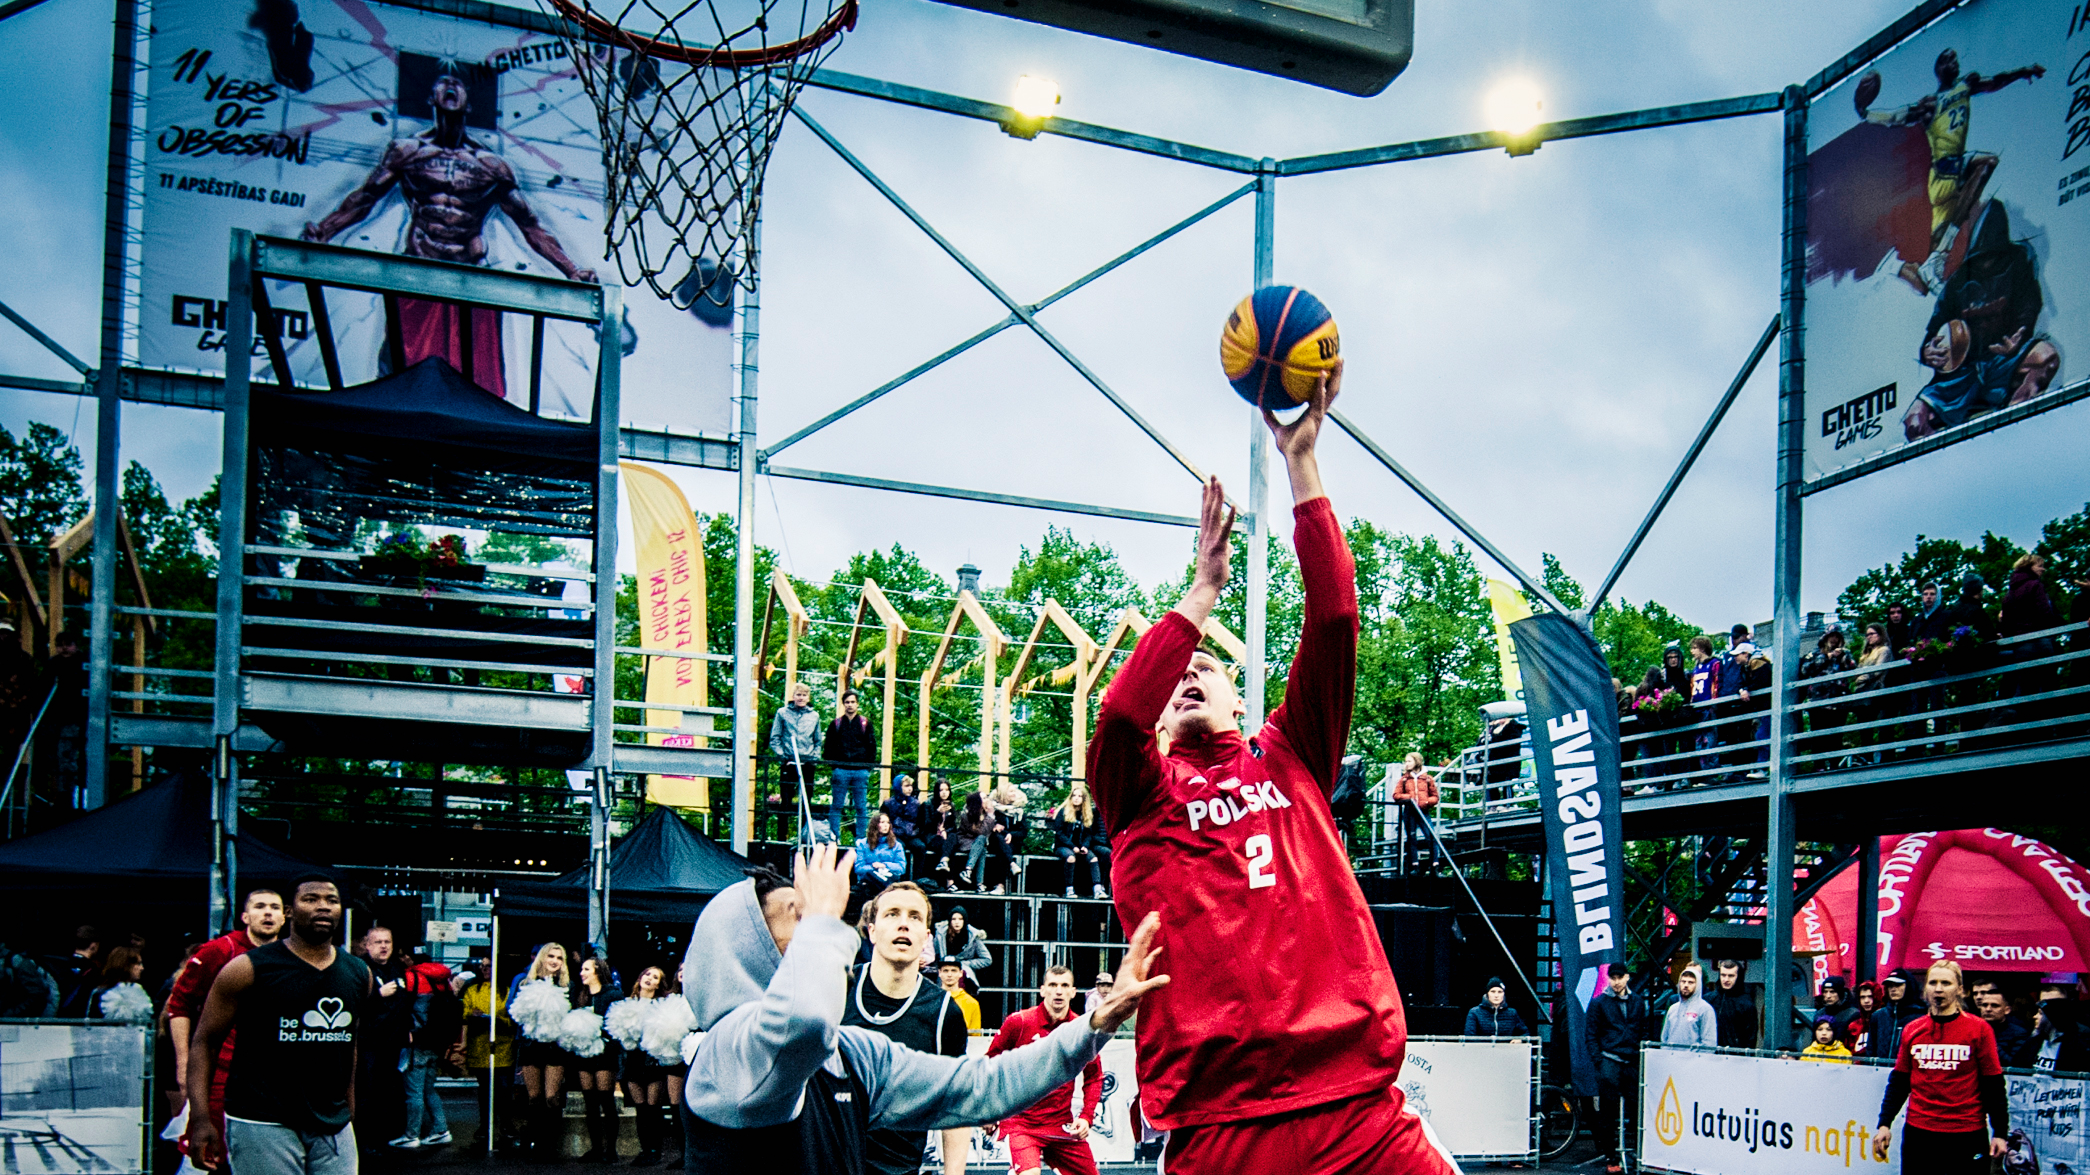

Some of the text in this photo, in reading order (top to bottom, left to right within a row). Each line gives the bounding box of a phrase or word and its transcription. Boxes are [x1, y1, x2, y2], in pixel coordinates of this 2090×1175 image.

[173, 48, 213, 84] 11
[495, 41, 568, 75] GHETTO
[214, 102, 266, 128] OF
[1948, 105, 1967, 131] 23
[159, 172, 306, 208] 11 APSĒSTĪBAS GADI
[1821, 381, 1897, 438] GHETTO
[1834, 416, 1883, 451] GAMES
[1245, 834, 1277, 889] 2
[1954, 945, 2065, 960] SPORTLAND
[279, 1029, 352, 1042] be.brussels
[280, 1016, 299, 1029] be
[1911, 1043, 1971, 1062] GHETTO
[1693, 1101, 1794, 1154] latvijas
[2049, 1121, 2073, 1138] KIDS
